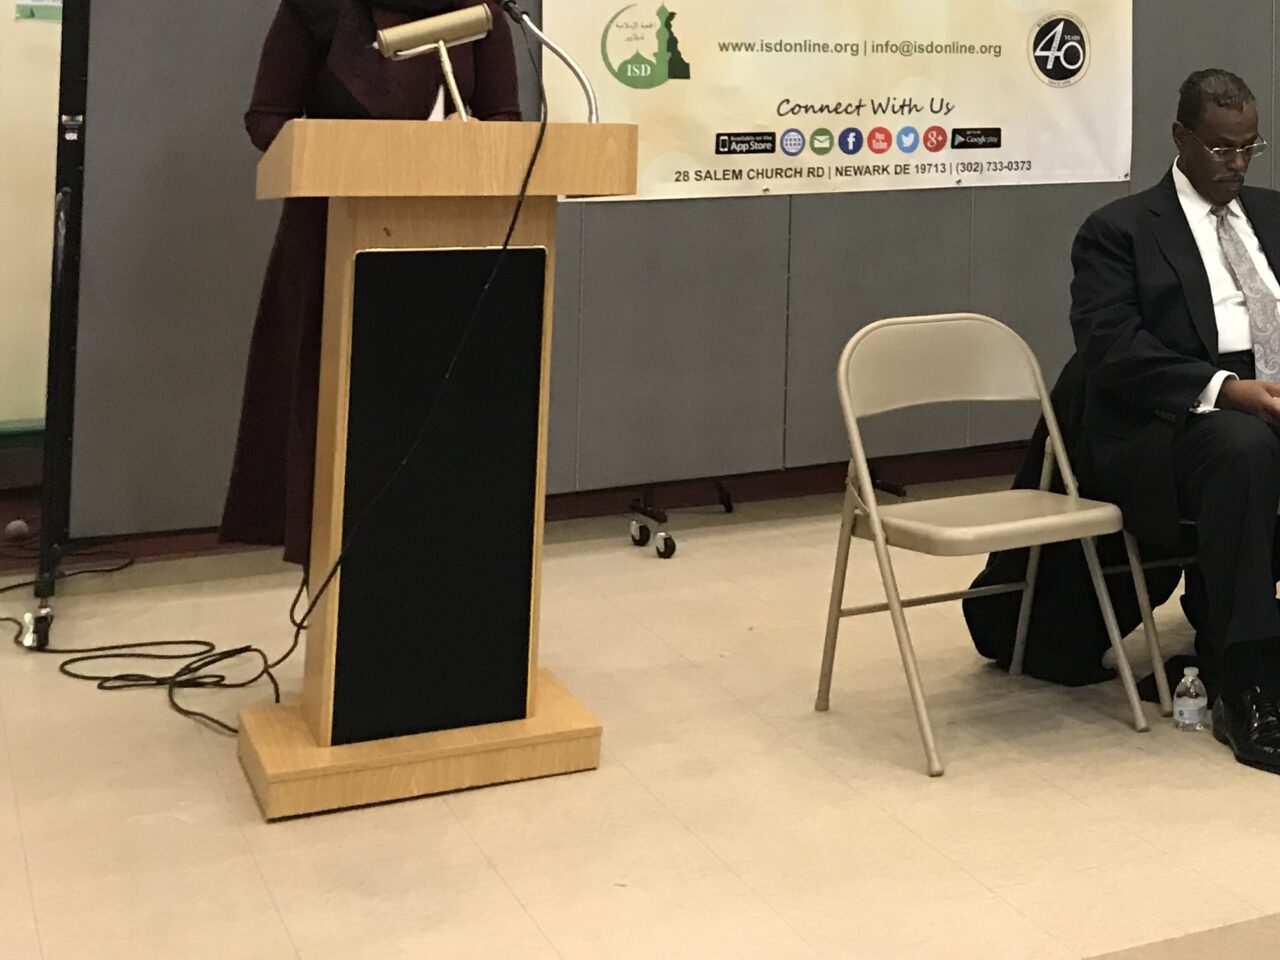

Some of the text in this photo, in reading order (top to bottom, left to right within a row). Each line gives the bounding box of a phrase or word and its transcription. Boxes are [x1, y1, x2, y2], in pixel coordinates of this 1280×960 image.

[717, 39, 860, 57] www.isdonline.org
[871, 40, 1002, 58] info@isdonline.org
[1034, 20, 1084, 70] 40
[627, 63, 652, 77] ISD
[776, 96, 956, 117] Connect With Us
[730, 140, 773, 153] App Store
[674, 170, 690, 183] 28
[694, 168, 743, 182] SALEM
[747, 166, 803, 180] CHURCH
[807, 166, 825, 178] RD
[835, 164, 891, 178] NEWARK
[894, 163, 911, 176] DE
[914, 162, 947, 176] 19713
[955, 161, 984, 176] (302)
[986, 159, 1033, 173] 733-0373
